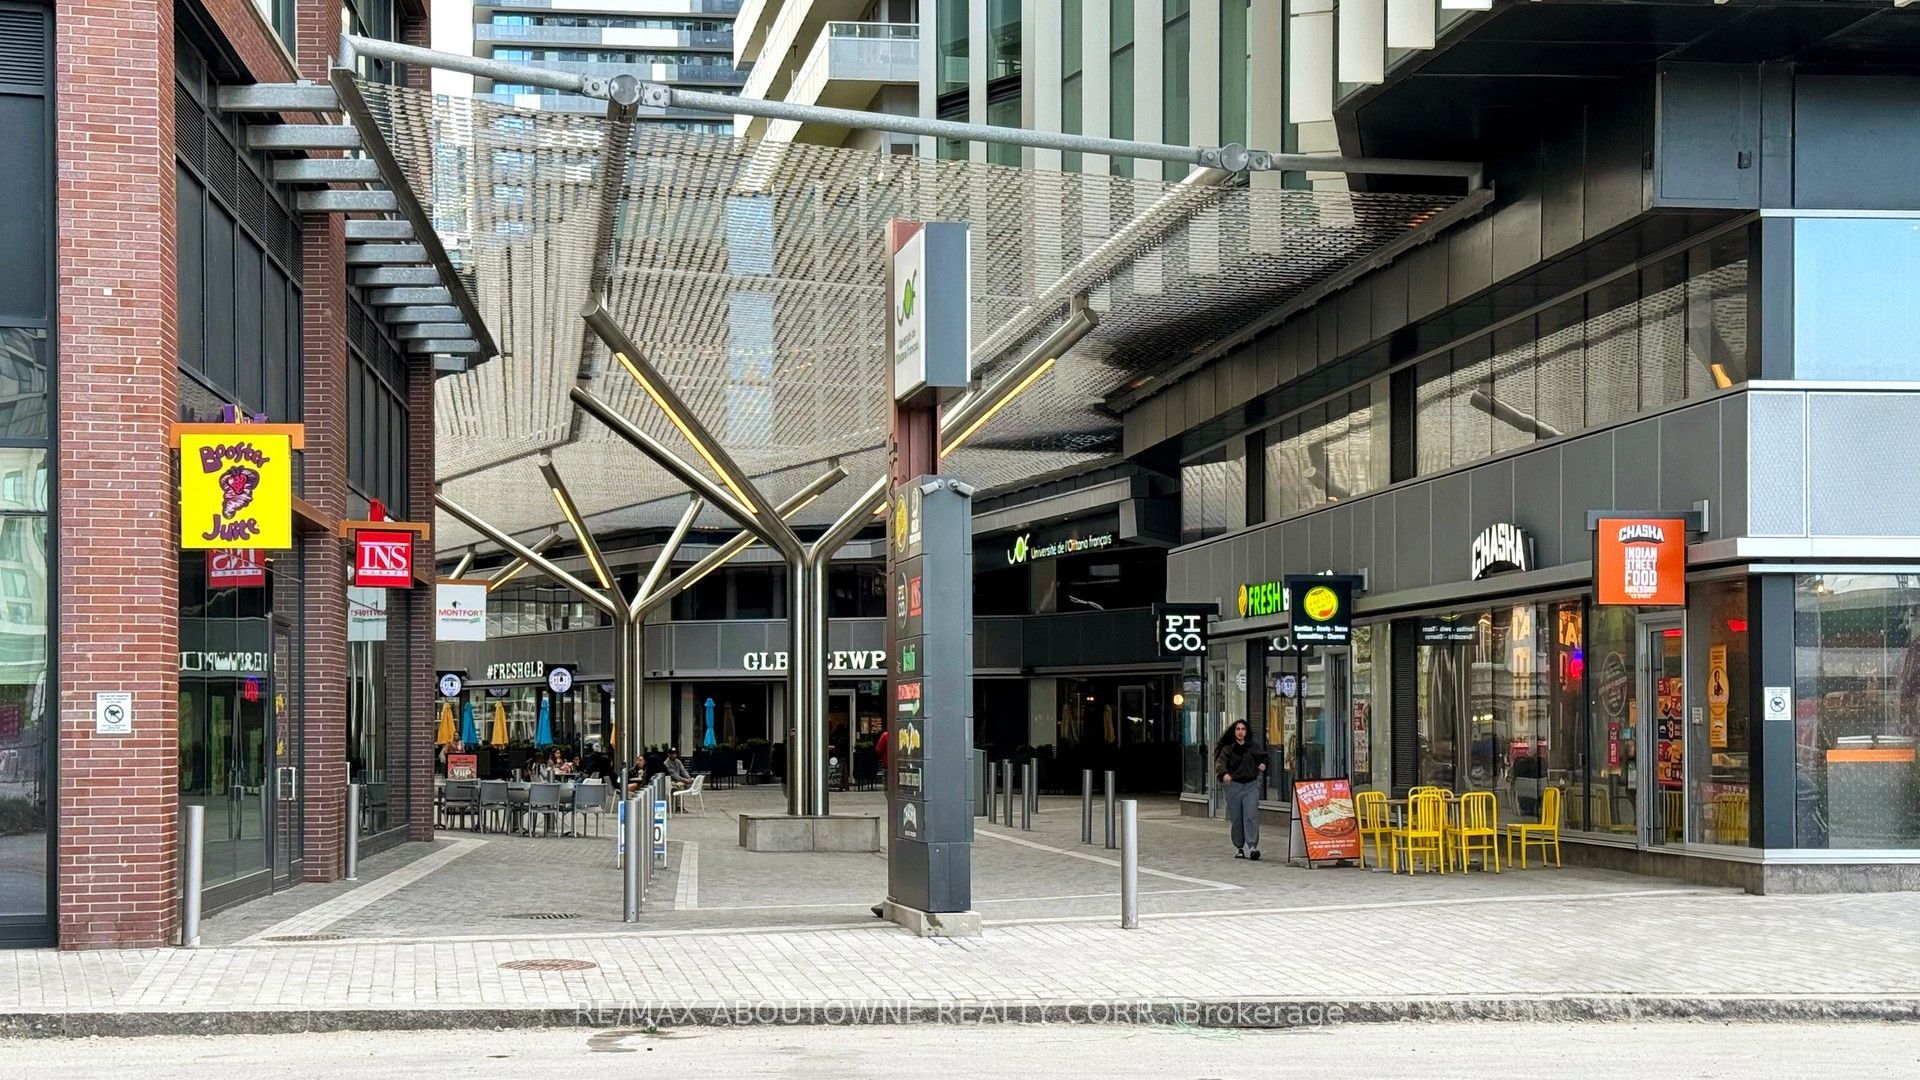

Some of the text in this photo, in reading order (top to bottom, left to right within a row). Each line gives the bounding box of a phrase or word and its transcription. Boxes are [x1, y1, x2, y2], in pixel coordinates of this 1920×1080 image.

[199, 441, 270, 474] Booster
[202, 514, 260, 541] Juice
[1618, 524, 1665, 542] CHASKA
[361, 545, 407, 570] INS
[1031, 543, 1057, 559] Université
[1057, 541, 1065, 554] de
[1471, 523, 1526, 581] CHASKA
[1624, 546, 1658, 559] INDIAN
[1624, 560, 1657, 570] STREET
[1624, 570, 1658, 586] FOOD
[1248, 581, 1281, 615] FRESH
[1165, 615, 1201, 633] PI
[486, 660, 544, 679] #FRESHGLB
